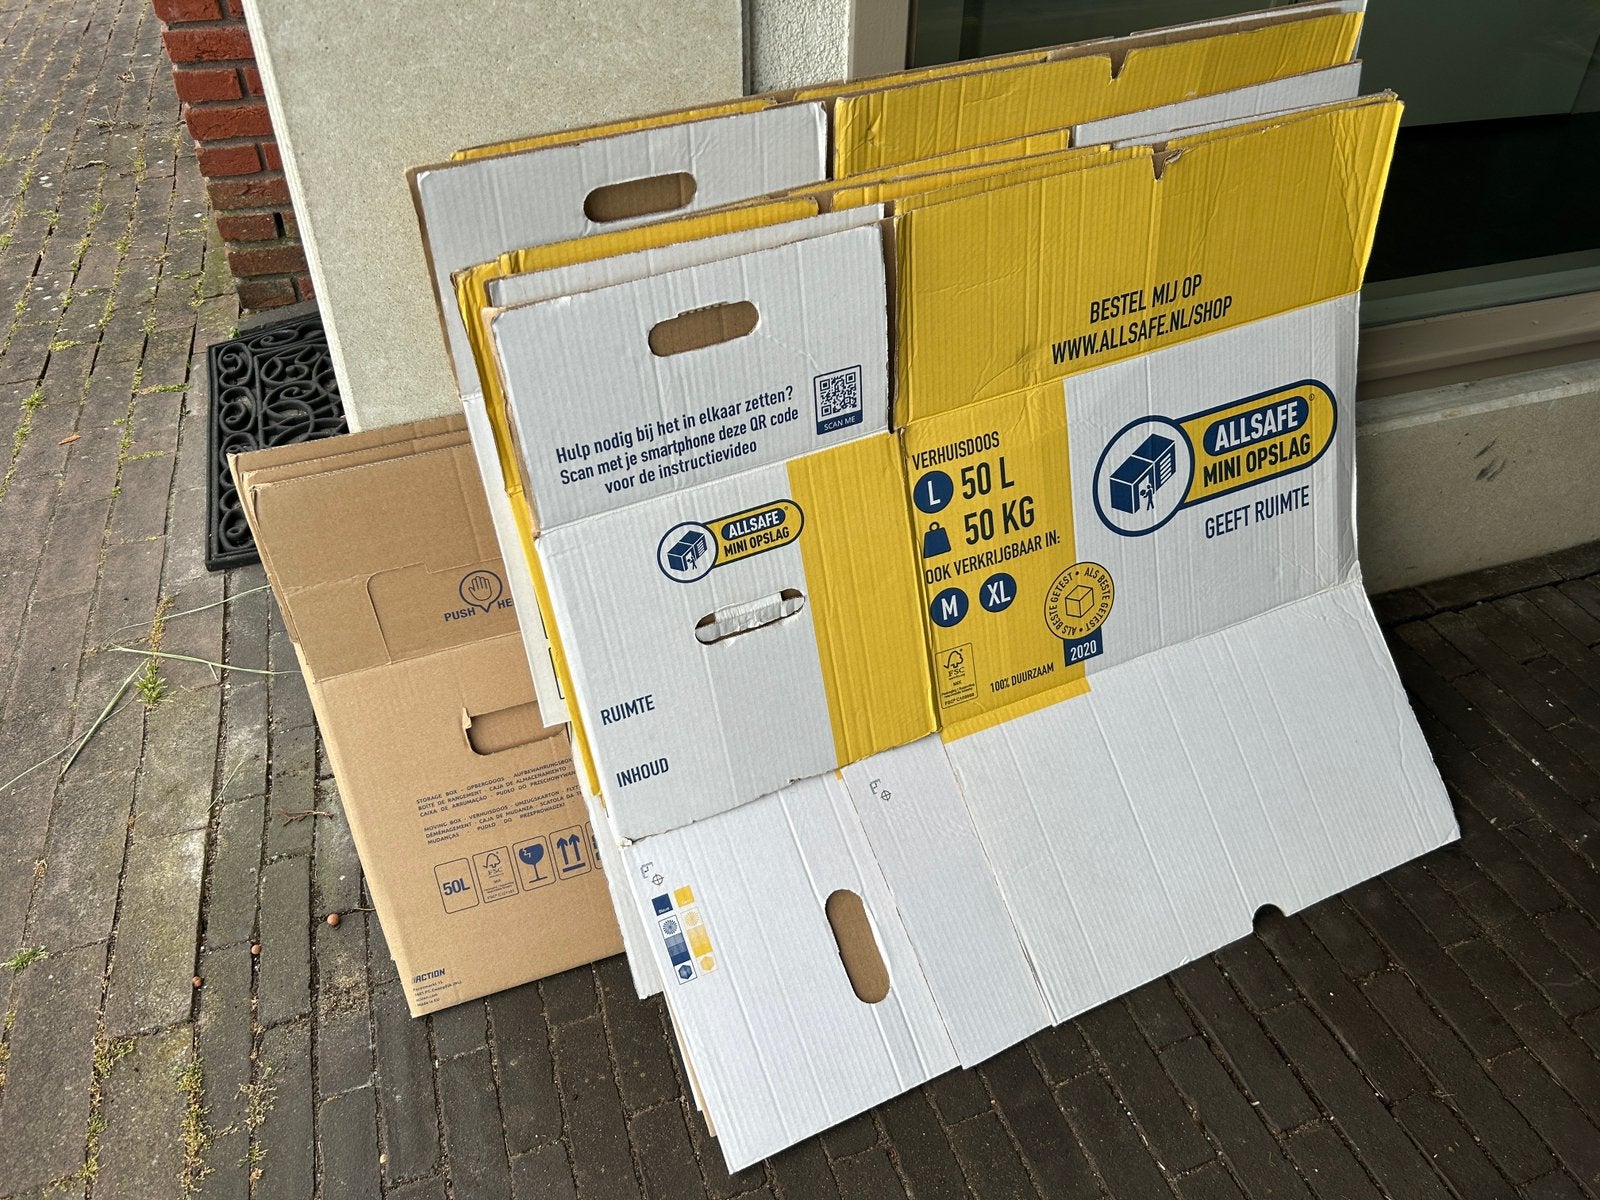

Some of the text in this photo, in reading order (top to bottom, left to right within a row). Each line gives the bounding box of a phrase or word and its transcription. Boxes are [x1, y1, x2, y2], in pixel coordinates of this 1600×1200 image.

[1090, 274, 1202, 324] BESTEL MIJ OP
[1052, 295, 1232, 365] WWW.ALLSAFE.NL/SHOP
[556, 385, 793, 464] Hulp nodig bij het in elkaar zetten?
[824, 416, 856, 431] SCAN ME
[1214, 401, 1298, 452] ALLSAFE
[560, 407, 799, 485] Scan met je smartphone deze QR code
[912, 431, 1000, 470] VERHUISDOOS
[1203, 433, 1311, 488] MINI OPSLAG
[604, 441, 757, 494] voor de instructievideo
[927, 456, 1015, 506] L 50 L
[728, 510, 780, 538] ALLSAFE
[964, 496, 1035, 545] 50 KG
[1205, 485, 1309, 539] GEEFT RUIMTE
[723, 526, 790, 557] MINI OPSLAG
[925, 530, 1061, 585] OOK VERKRIJGBAAR IN:
[444, 598, 513, 622] PUSH HE
[941, 580, 1011, 620] M XL
[1049, 572, 1077, 636] ALS BESTE GETEST
[1084, 567, 1110, 632] ALS BESTE GETEST
[1070, 640, 1097, 661] 2020
[948, 667, 965, 677] FSC
[990, 678, 1010, 693] 100%
[1012, 662, 1054, 686] DUURZAAM
[600, 694, 655, 726] RUIMTE
[416, 794, 442, 804] STORAGE
[466, 776, 504, 790] OPBERGDOOS
[448, 790, 482, 803] RANGEMENT
[516, 766, 567, 784] ALMACENAMIENTO
[616, 758, 669, 788] INHOUD
[420, 809, 438, 817] CAIXA
[424, 822, 448, 832] MOVING
[468, 805, 508, 820] VERHUISDOOS
[514, 791, 560, 806] UMZUGSKARTON
[505, 805, 533, 816] MUDANZA
[540, 796, 564, 807] SCATOLA
[442, 877, 470, 896] 50L
[413, 968, 446, 983] ACTION
